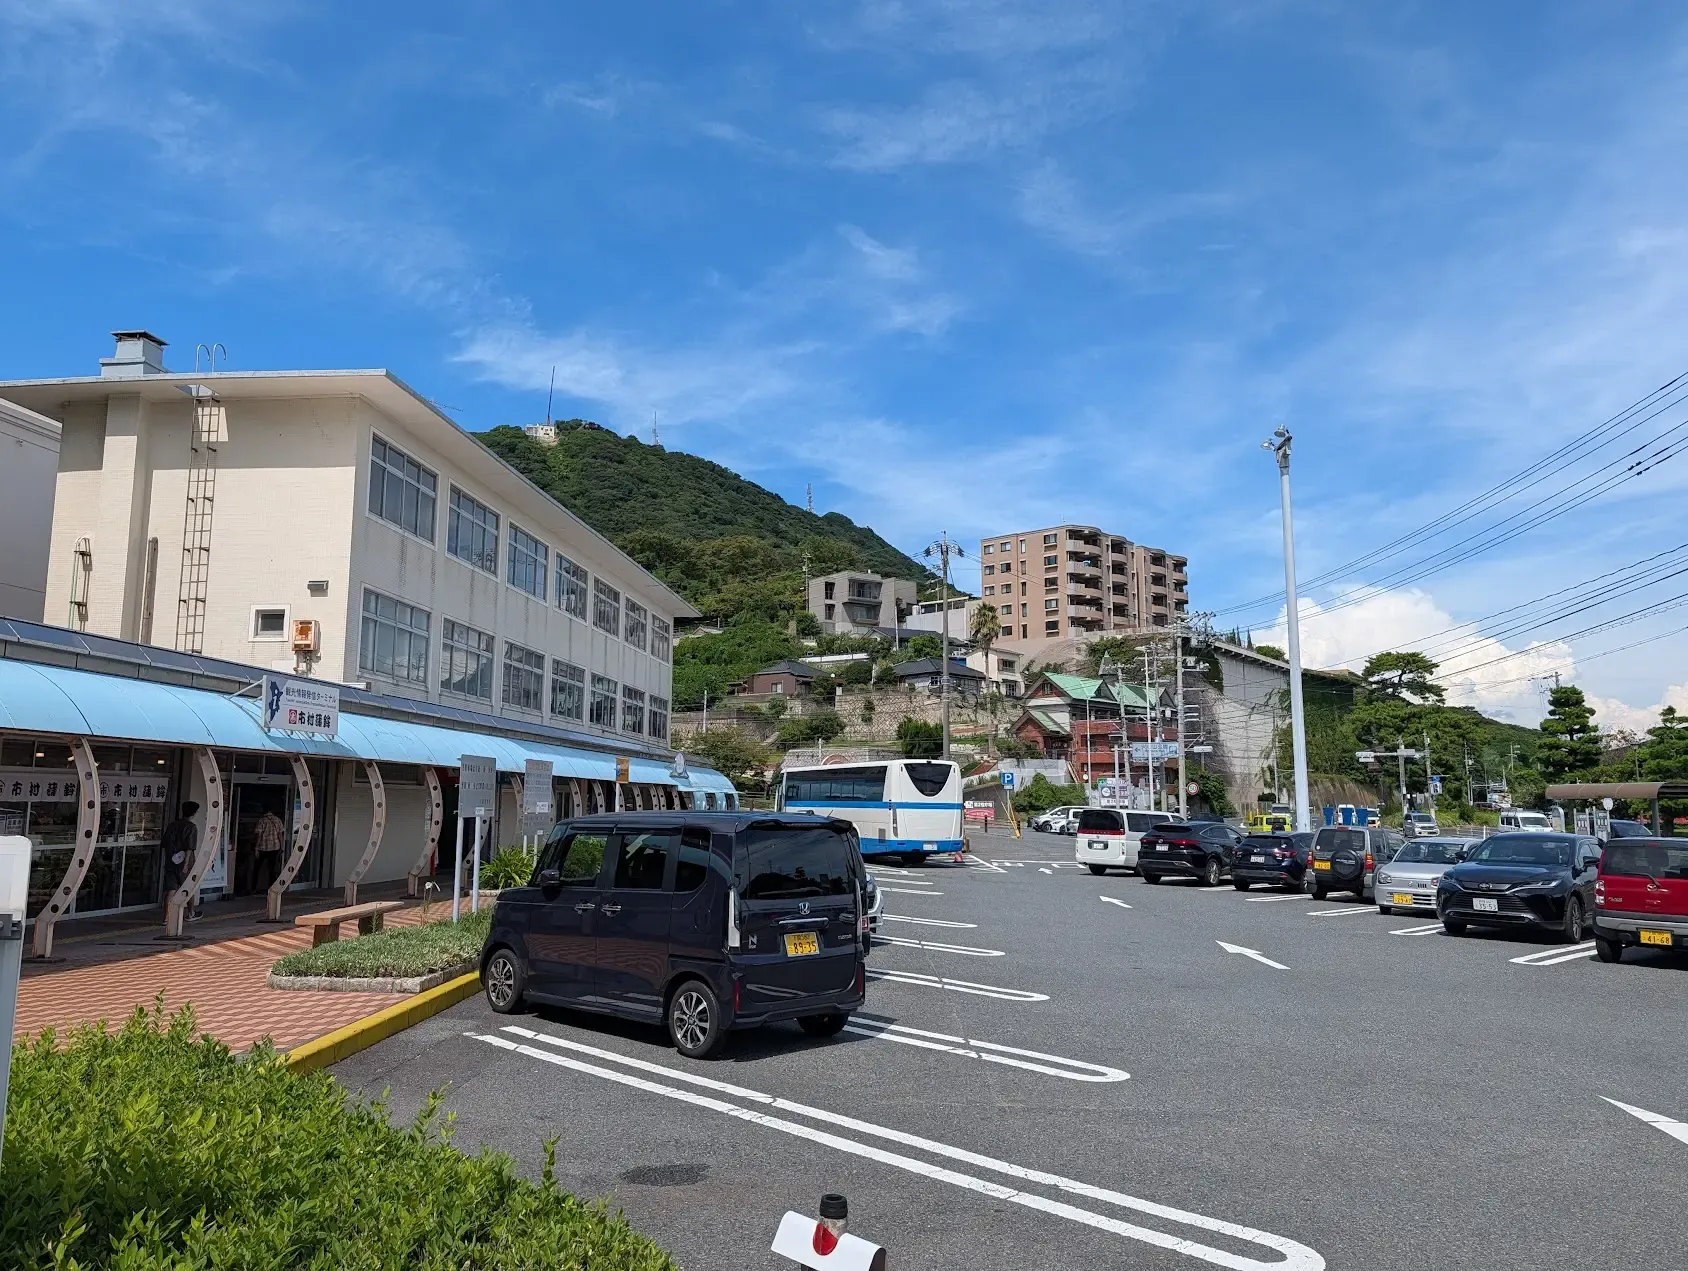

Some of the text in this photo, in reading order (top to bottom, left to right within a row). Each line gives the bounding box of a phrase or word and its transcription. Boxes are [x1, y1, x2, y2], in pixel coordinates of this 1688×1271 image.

[286, 687, 337, 704] 観光情報発信ターミナル
[298, 711, 331, 729] 市村蒲鉾
[1004, 773, 1013, 784] P
[11, 780, 76, 797] 市村蒲鉾
[113, 781, 166, 798] 市村蒲鉾
[793, 941, 817, 954] 89-35
[1647, 935, 1670, 944] 41-68
